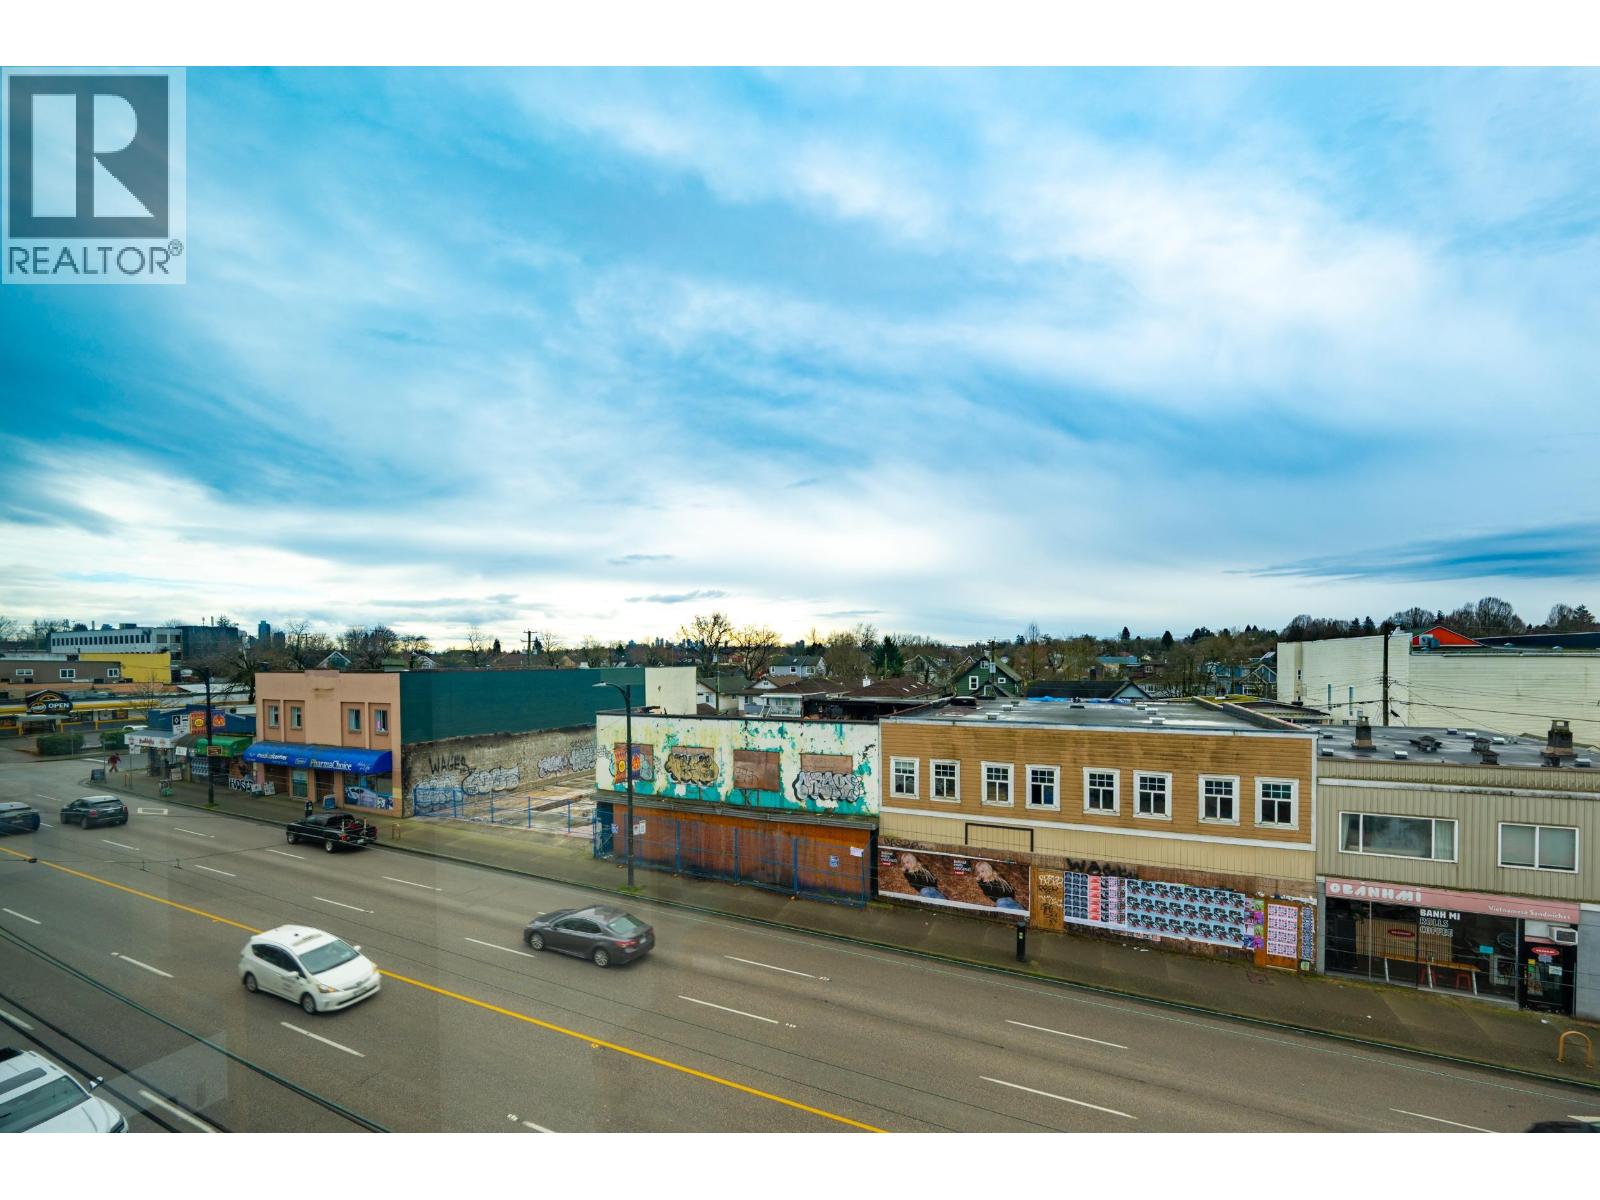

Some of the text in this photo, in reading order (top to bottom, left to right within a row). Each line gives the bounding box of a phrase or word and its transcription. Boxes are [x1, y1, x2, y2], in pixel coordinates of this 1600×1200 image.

[310, 759, 352, 771] PharmaChoice
[1420, 909, 1460, 920] BANH MI
[1488, 905, 1528, 916] Vietnamese
